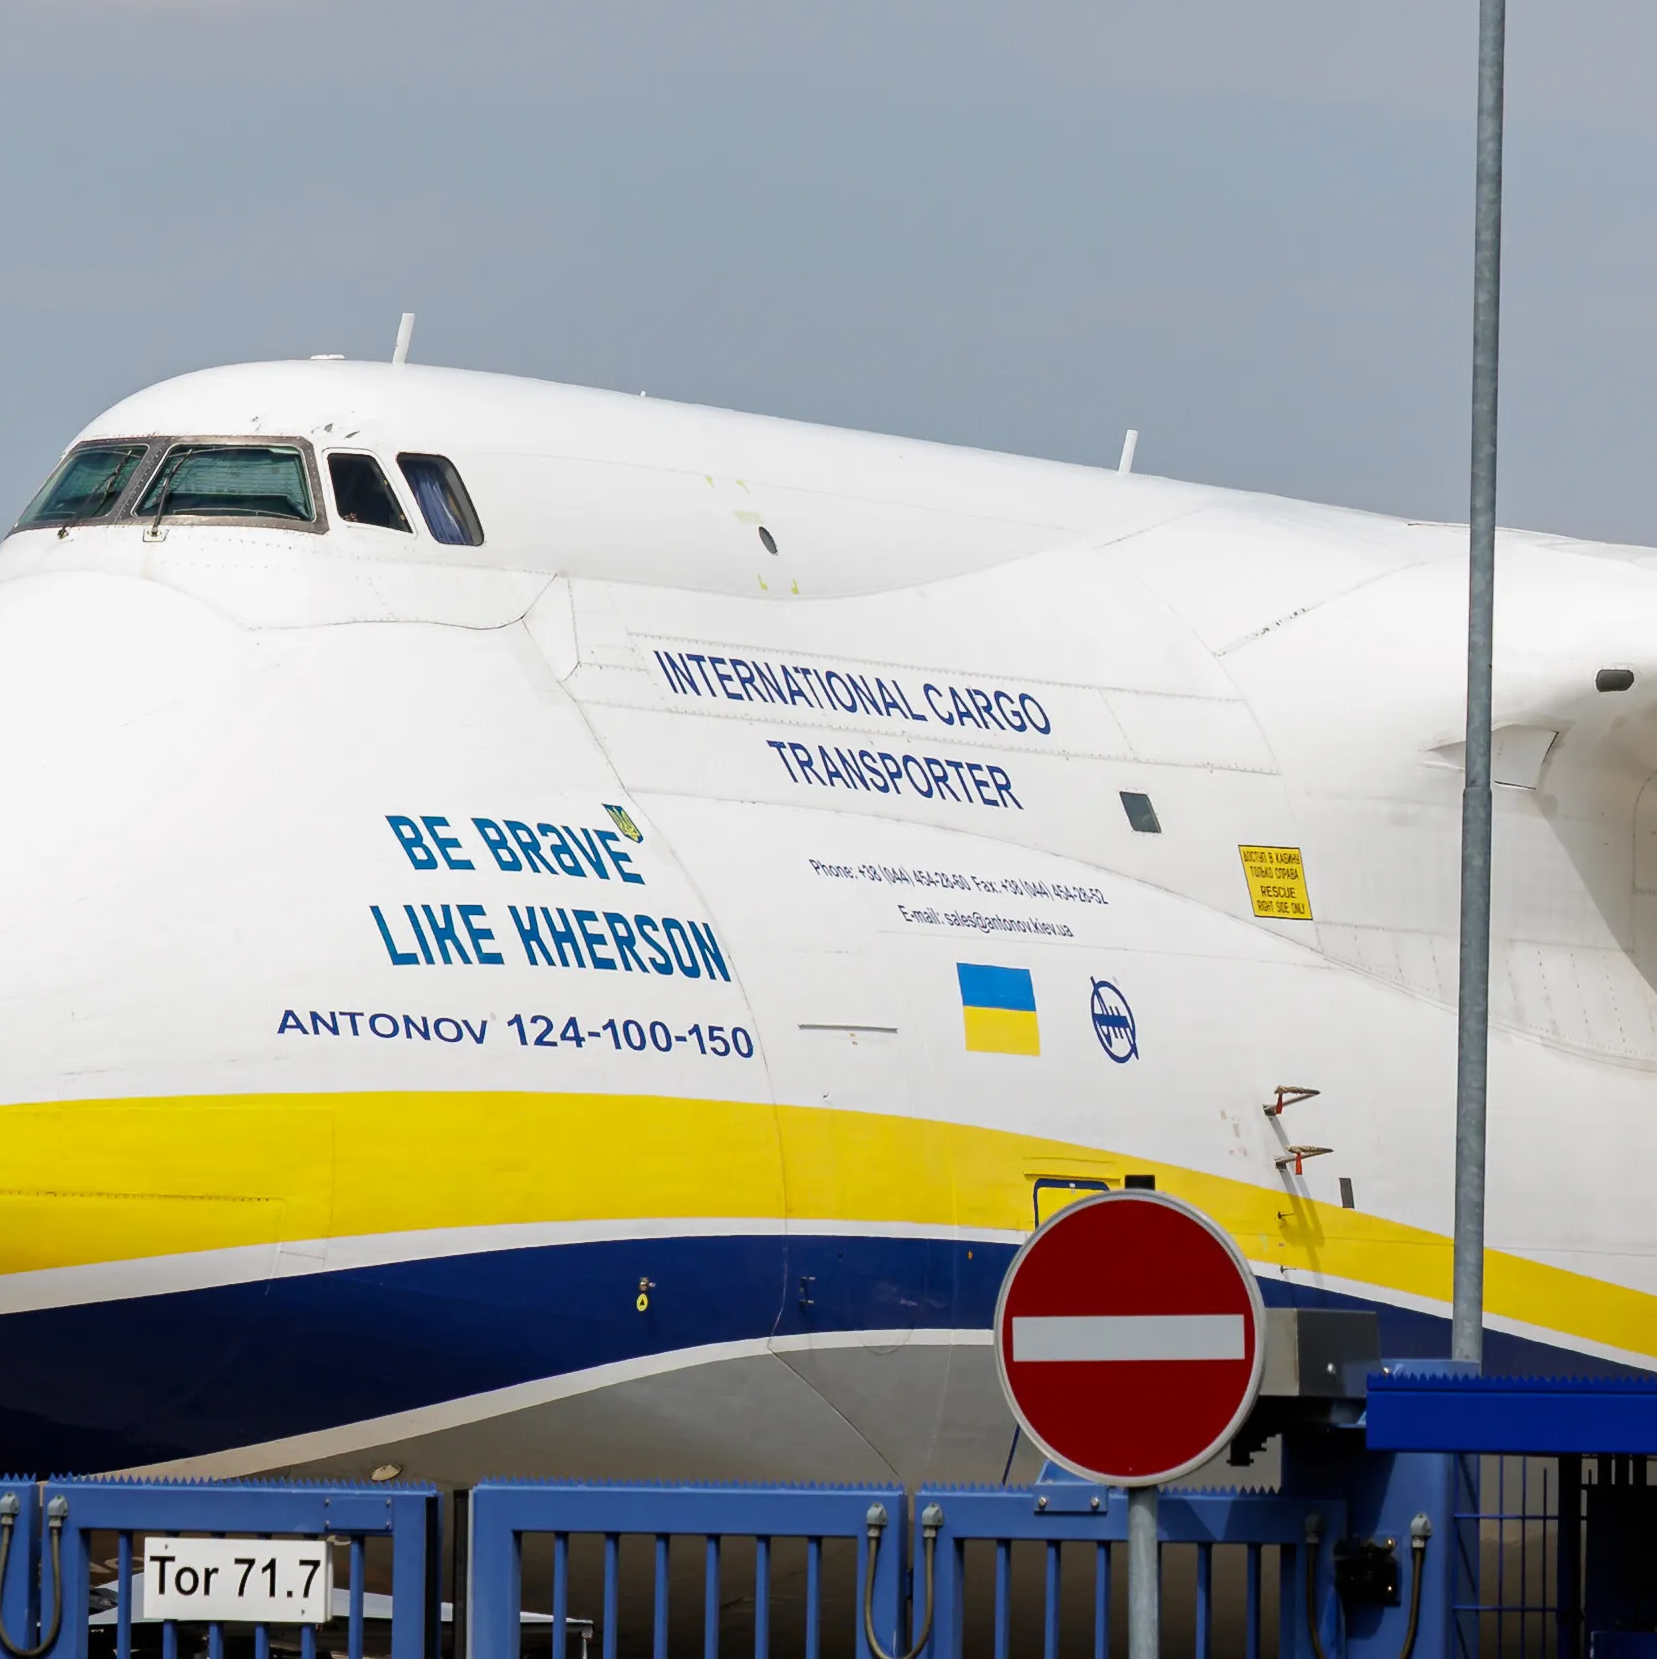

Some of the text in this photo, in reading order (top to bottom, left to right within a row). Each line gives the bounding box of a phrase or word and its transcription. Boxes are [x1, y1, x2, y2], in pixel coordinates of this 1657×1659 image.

[653, 650, 1051, 736] INTERNATIONAL CARGO
[766, 739, 1024, 810] TRANSPORTER
[385, 816, 477, 871] BE
[808, 858, 858, 880] Phone:
[858, 864, 880, 882] +38
[878, 864, 915, 886] (044)
[912, 869, 972, 892] 454-28-60
[970, 875, 1002, 895] Fax:
[1051, 884, 1109, 905] 454-28-52
[1260, 885, 1296, 899] RESCUE
[897, 904, 1074, 938] E-mail: sales@antonov.kiev.ua
[1256, 899, 1306, 915] RIGHT SIDE ONLY
[369, 904, 732, 983] LIKE KHERSON
[277, 1009, 754, 1059] ANTONOV 124-100-150
[149, 1555, 321, 1599] Tor 71.7
